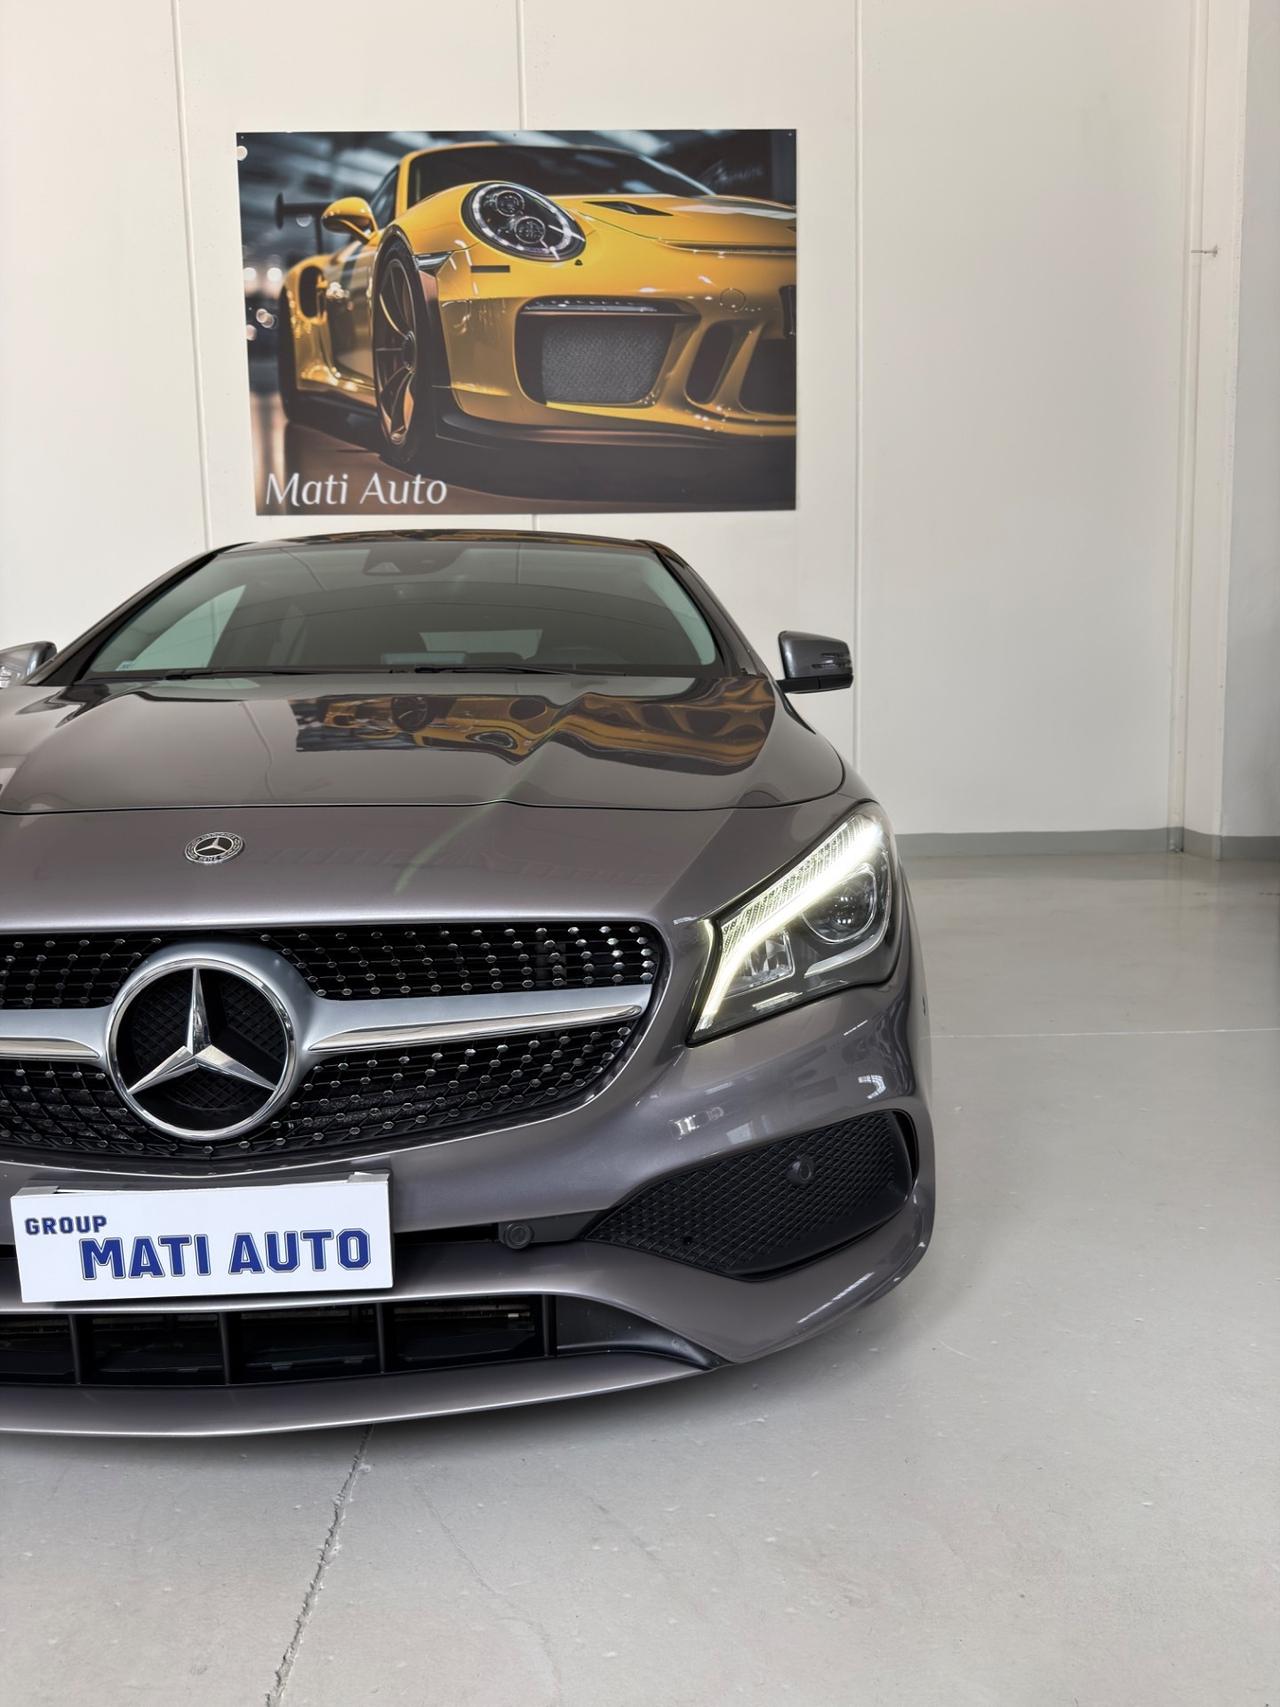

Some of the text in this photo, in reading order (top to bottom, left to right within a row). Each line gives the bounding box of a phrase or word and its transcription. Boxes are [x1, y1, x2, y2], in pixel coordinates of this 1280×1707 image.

[266, 472, 448, 507] Mati Auto
[25, 1215, 108, 1236] GROUP
[79, 1228, 371, 1280] MATI AUTO
